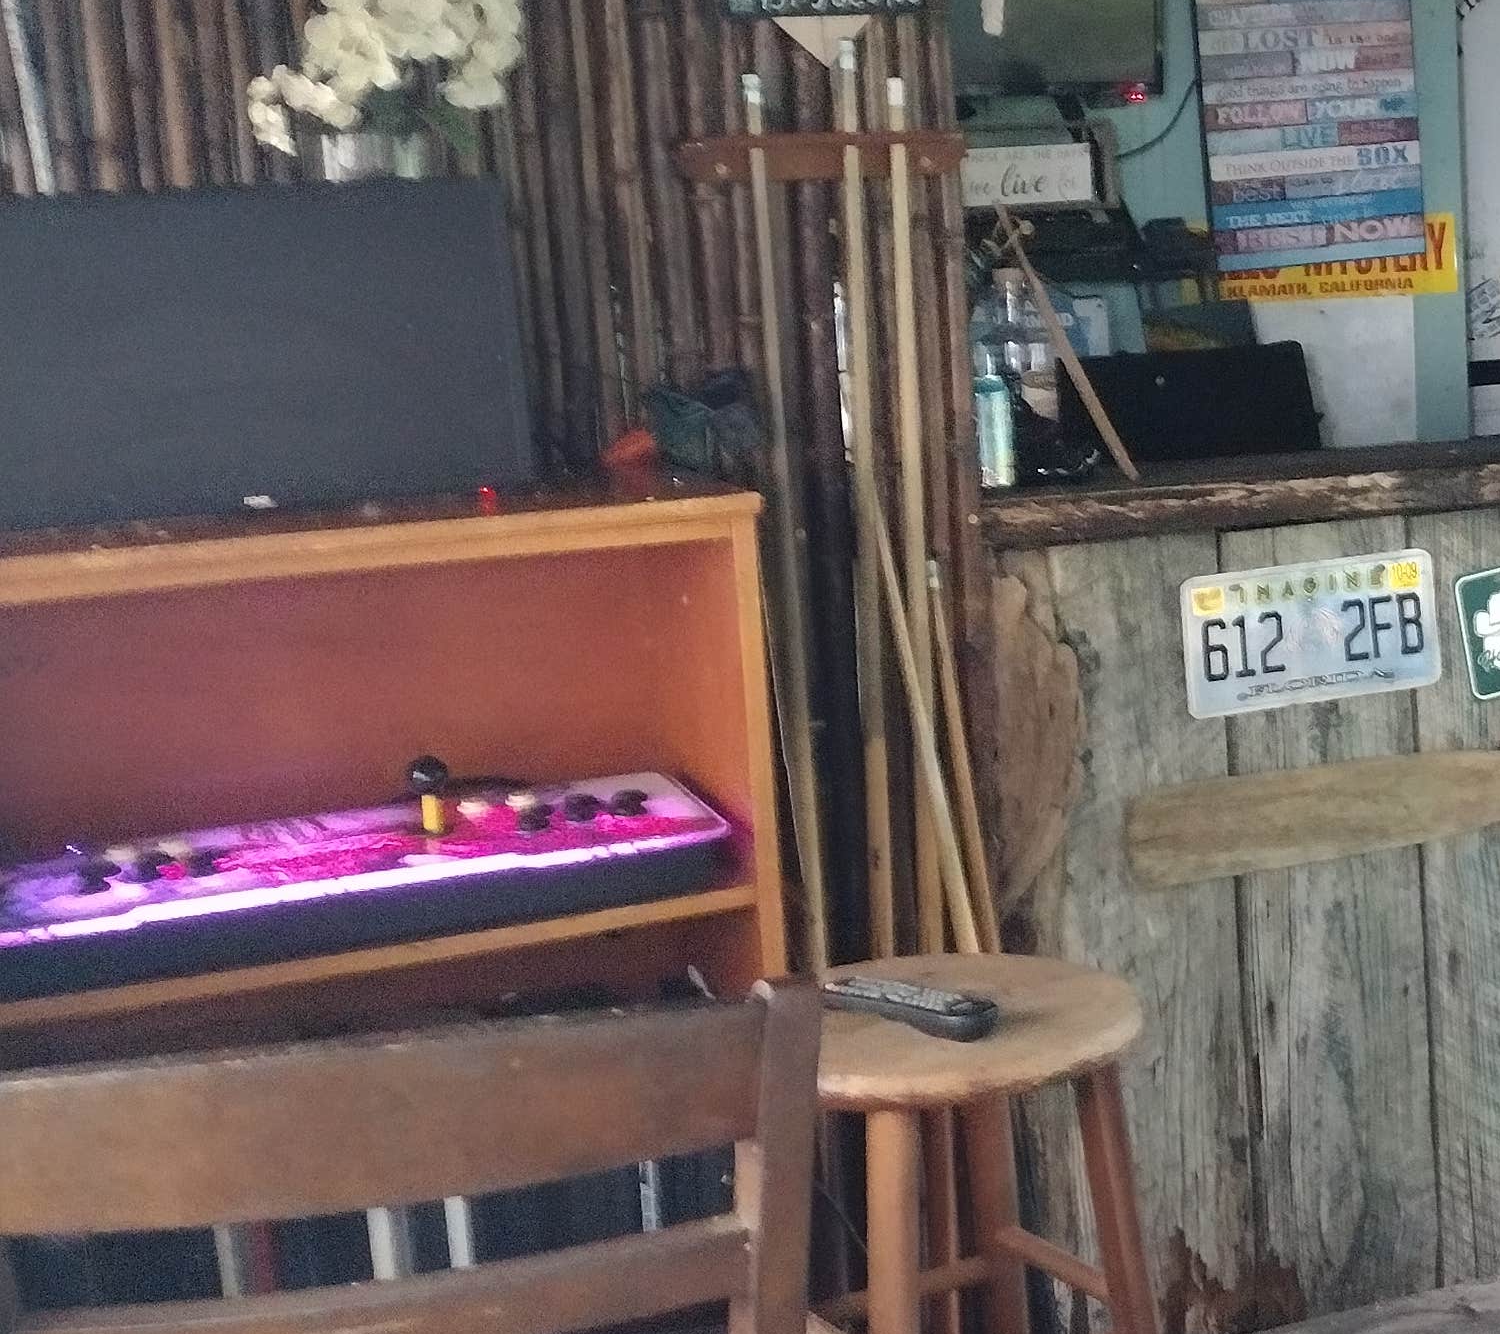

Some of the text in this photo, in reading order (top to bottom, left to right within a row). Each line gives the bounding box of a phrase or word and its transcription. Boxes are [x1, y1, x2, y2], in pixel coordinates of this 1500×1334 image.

[1243, 27, 1319, 52] LOST
[1000, 163, 1049, 198] live
[1335, 216, 1411, 242] NOW
[1226, 277, 1414, 301] KLAMATH, CALIFORNIA
[1202, 591, 1426, 683] 612 2FB
[1247, 666, 1398, 699] FLORIDA
